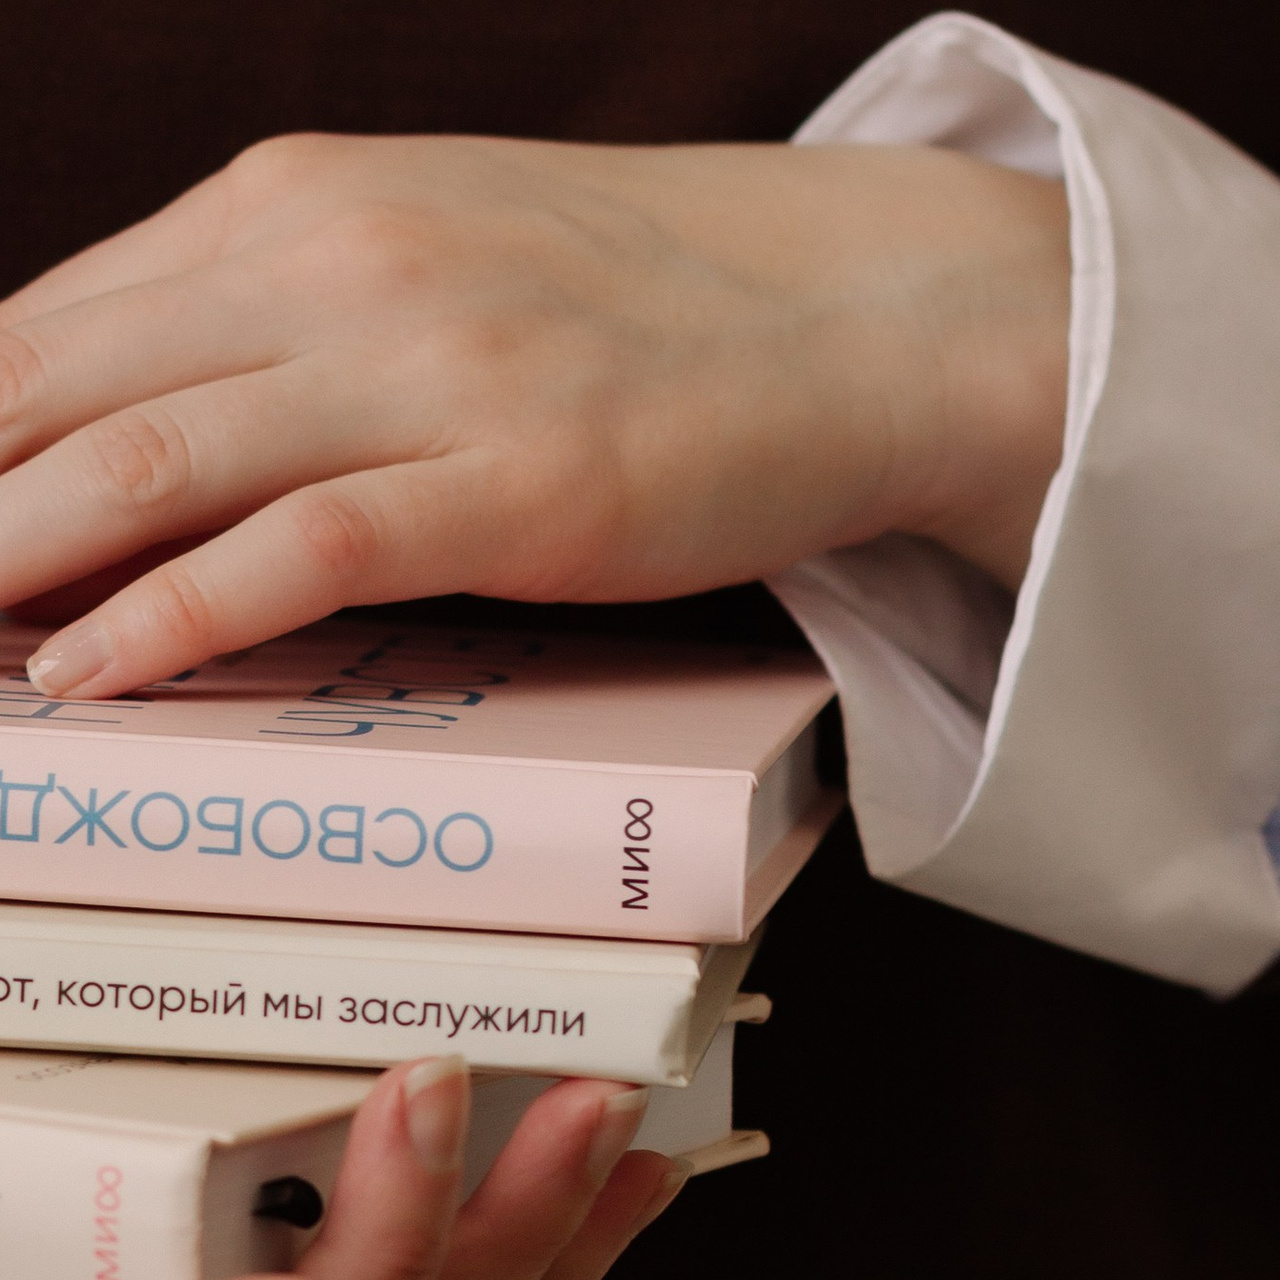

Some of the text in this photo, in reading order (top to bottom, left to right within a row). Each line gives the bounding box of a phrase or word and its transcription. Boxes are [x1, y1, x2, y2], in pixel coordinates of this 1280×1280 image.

[57, 979, 247, 1022] который
[262, 991, 323, 1021] мы
[338, 996, 587, 1039] заслужили
